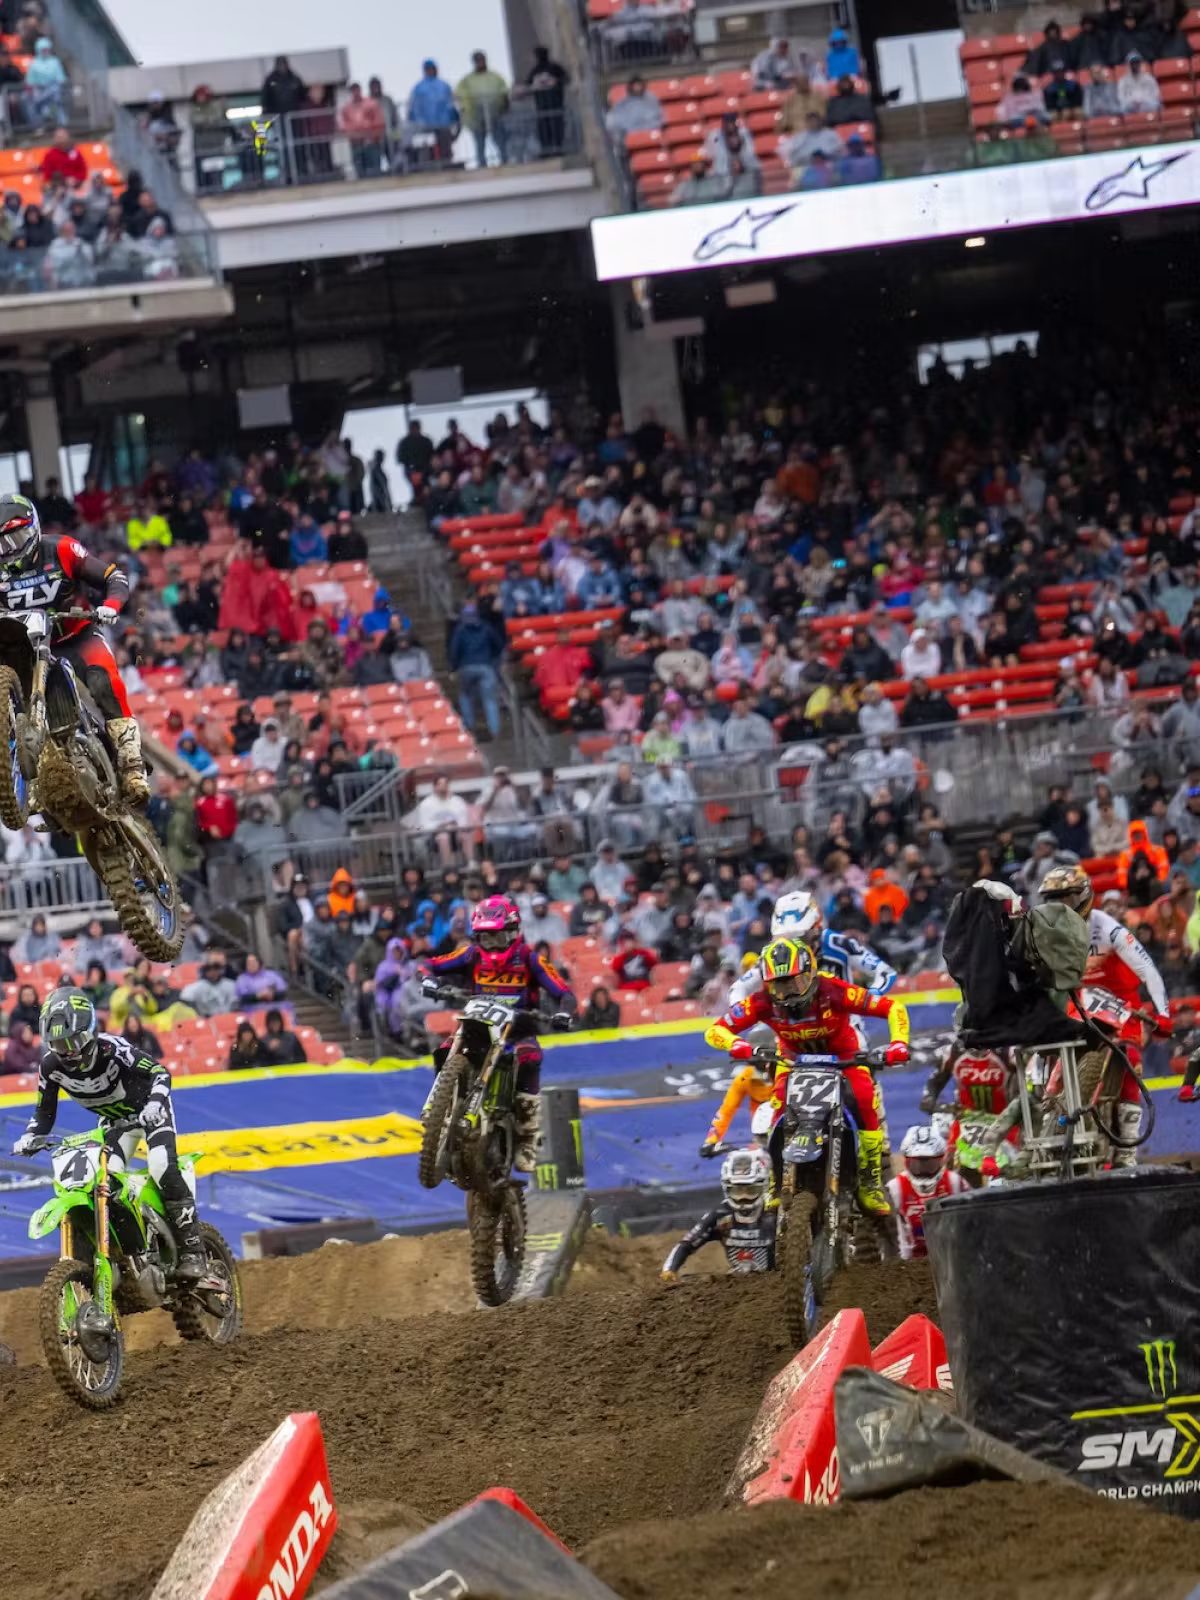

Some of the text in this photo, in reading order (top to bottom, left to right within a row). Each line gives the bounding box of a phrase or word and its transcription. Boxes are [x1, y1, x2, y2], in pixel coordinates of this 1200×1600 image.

[7, 578, 62, 609] FLY
[959, 1067, 1001, 1081] FXR
[789, 1073, 836, 1111] 32
[59, 1150, 89, 1182] 4
[1097, 1486, 1139, 1500] ORLD
